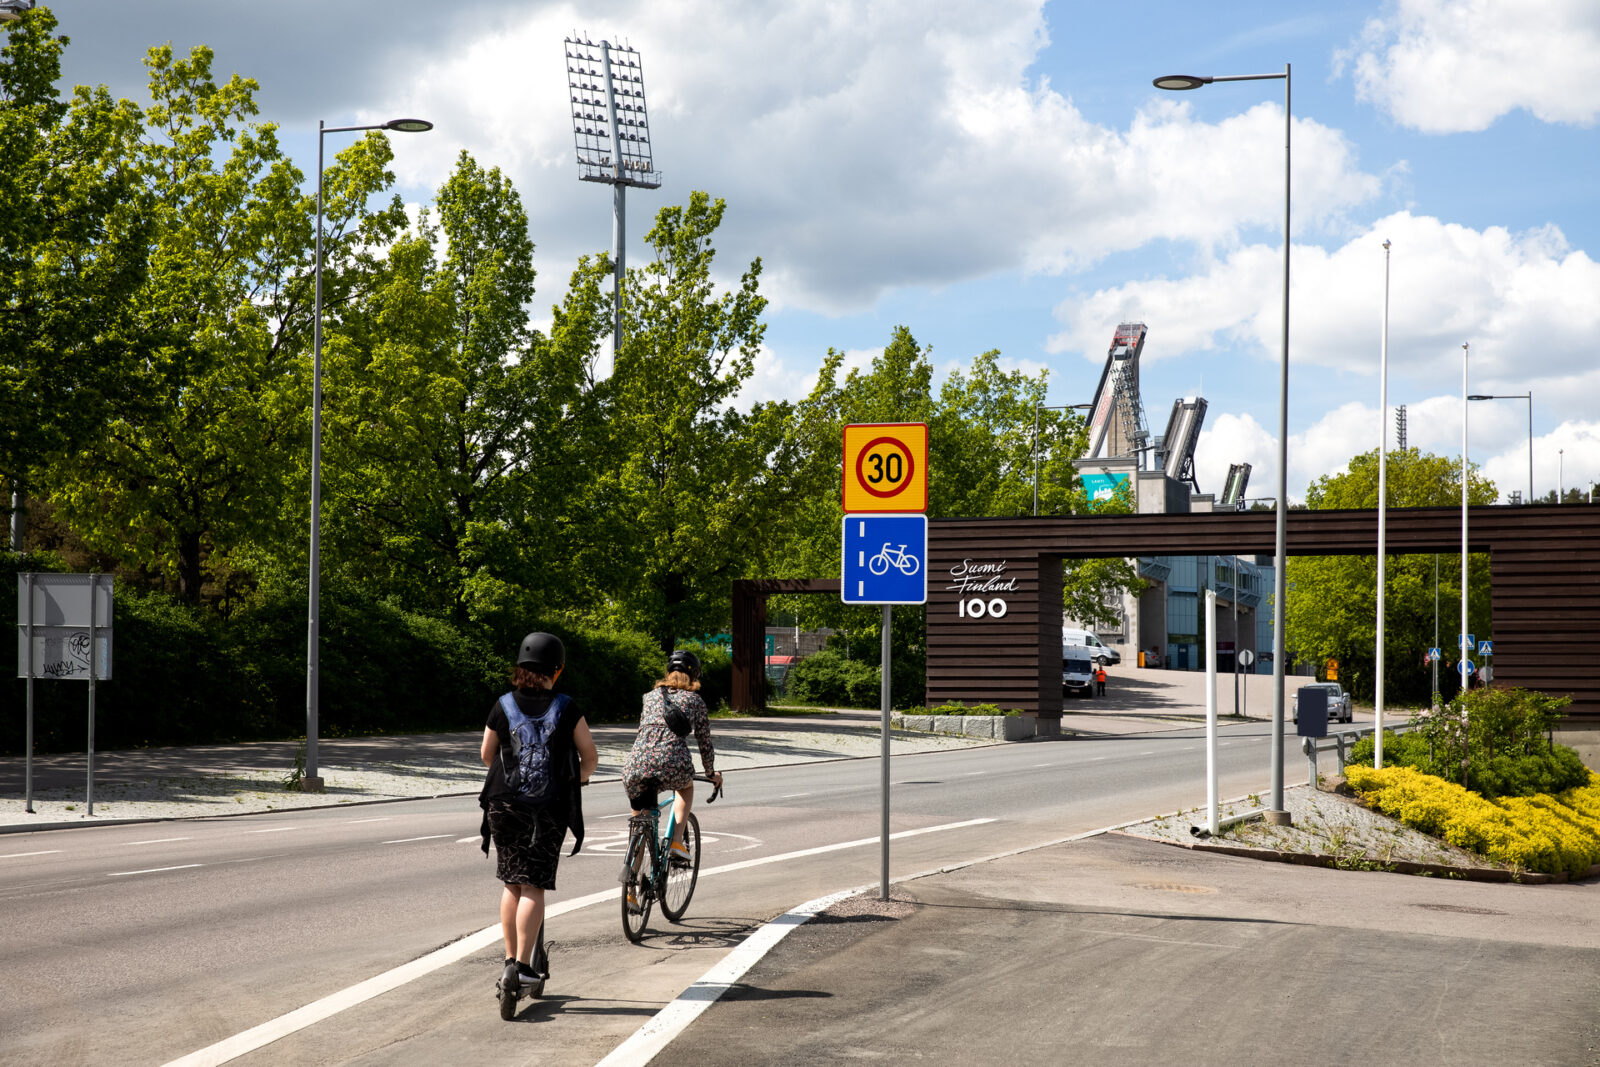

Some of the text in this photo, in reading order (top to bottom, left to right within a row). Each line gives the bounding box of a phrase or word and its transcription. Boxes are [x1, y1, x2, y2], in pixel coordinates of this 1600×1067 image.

[867, 452, 903, 484] 30
[949, 558, 1007, 576] Suomi
[945, 575, 1020, 595] Finland
[958, 597, 1007, 618] 100
